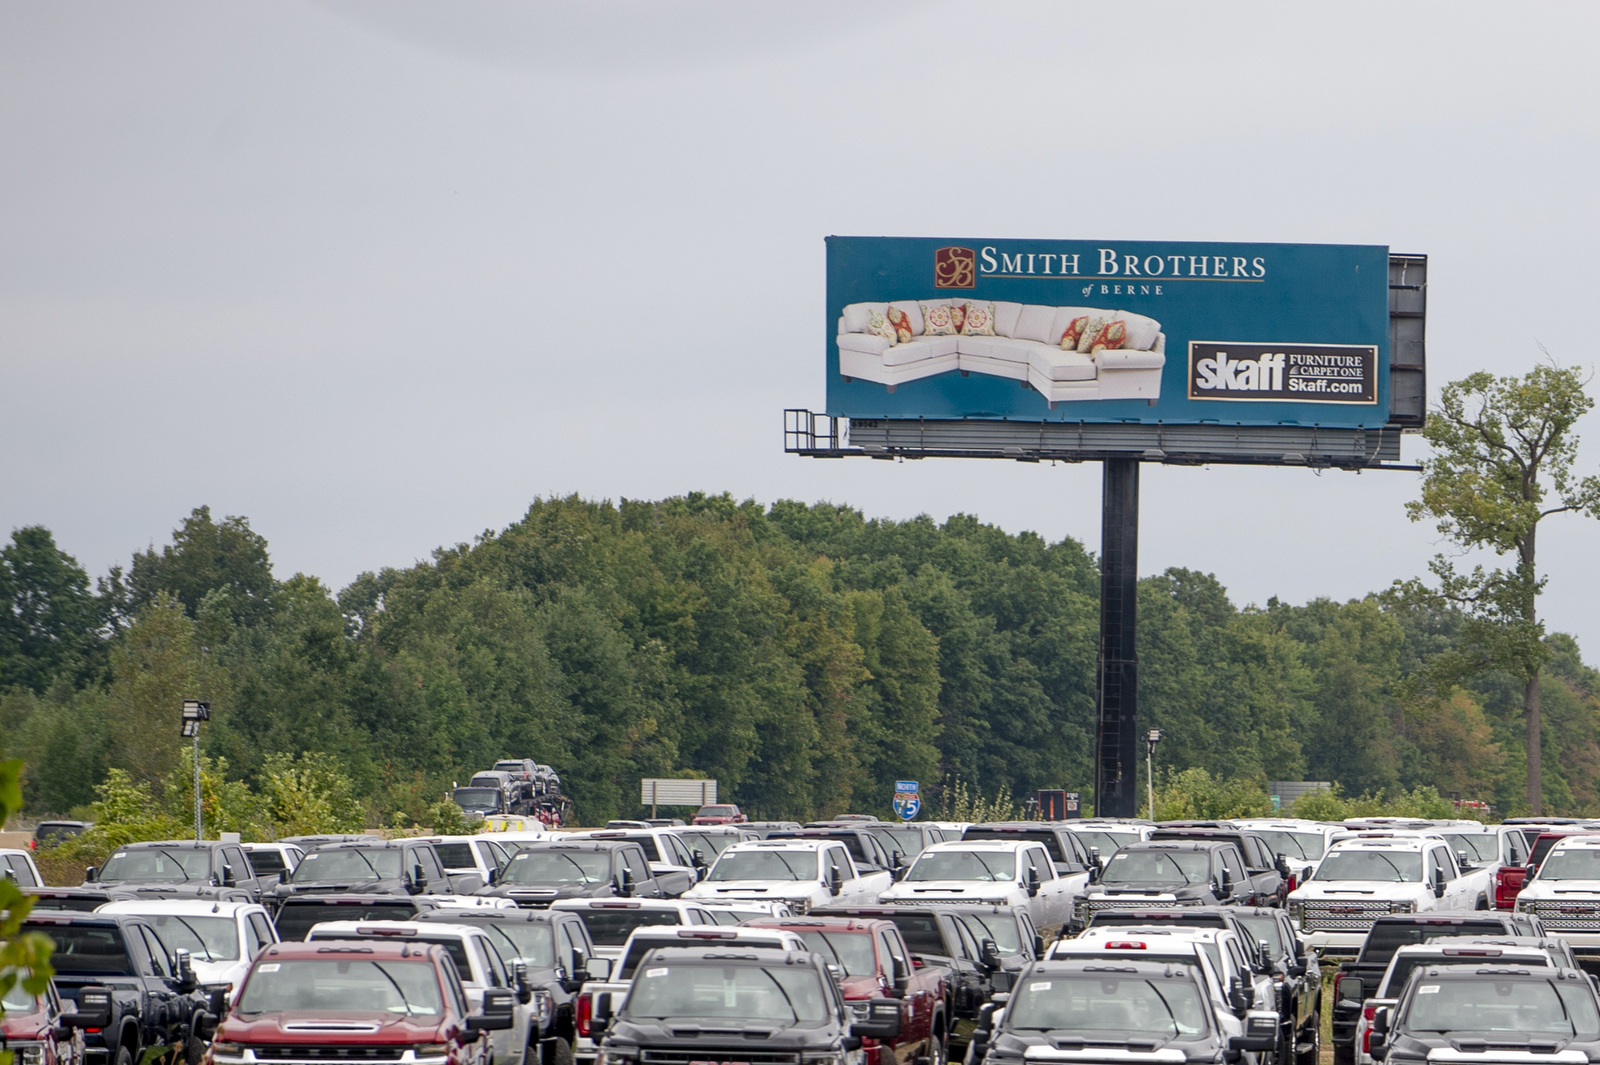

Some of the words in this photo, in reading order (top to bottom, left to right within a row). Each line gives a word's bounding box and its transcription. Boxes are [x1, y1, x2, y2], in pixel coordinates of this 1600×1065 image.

[980, 246, 1080, 274] SMITH
[1097, 248, 1266, 277] BROTHERS
[1082, 284, 1095, 297] of
[1101, 285, 1163, 295] BERNE
[1289, 354, 1363, 367] FURNITURE
[1196, 352, 1285, 391] skaff
[1300, 366, 1340, 376] CARPET
[1340, 367, 1363, 377] ONE
[1288, 378, 1363, 393] Skaff.com
[896, 799, 917, 815] 75
[1329, 906, 1364, 914] GMC
[1560, 906, 1595, 914] GMC
